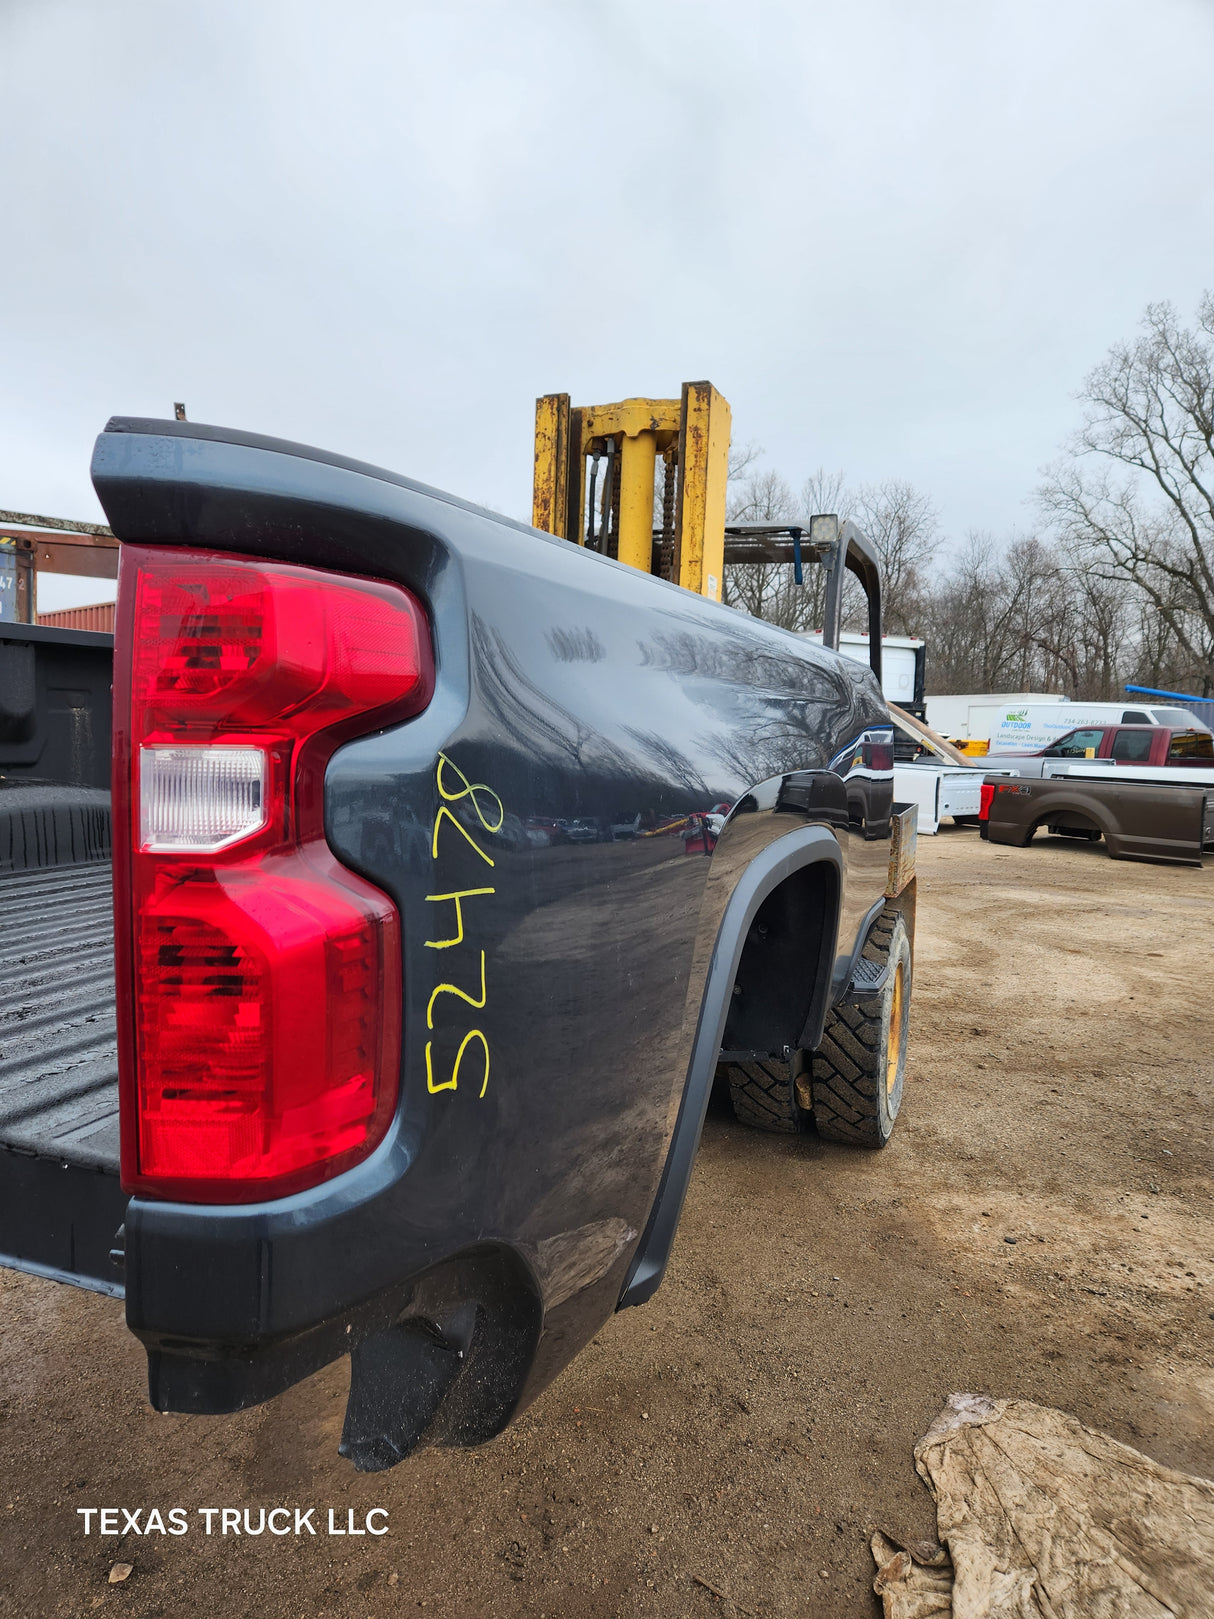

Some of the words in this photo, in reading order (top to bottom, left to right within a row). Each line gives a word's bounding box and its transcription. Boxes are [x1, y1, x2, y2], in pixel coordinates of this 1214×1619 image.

[1001, 721, 1032, 729] OUTDOOR
[997, 732, 1025, 742] Landscape
[1026, 734, 1046, 742] Design
[423, 750, 504, 1100] 52478
